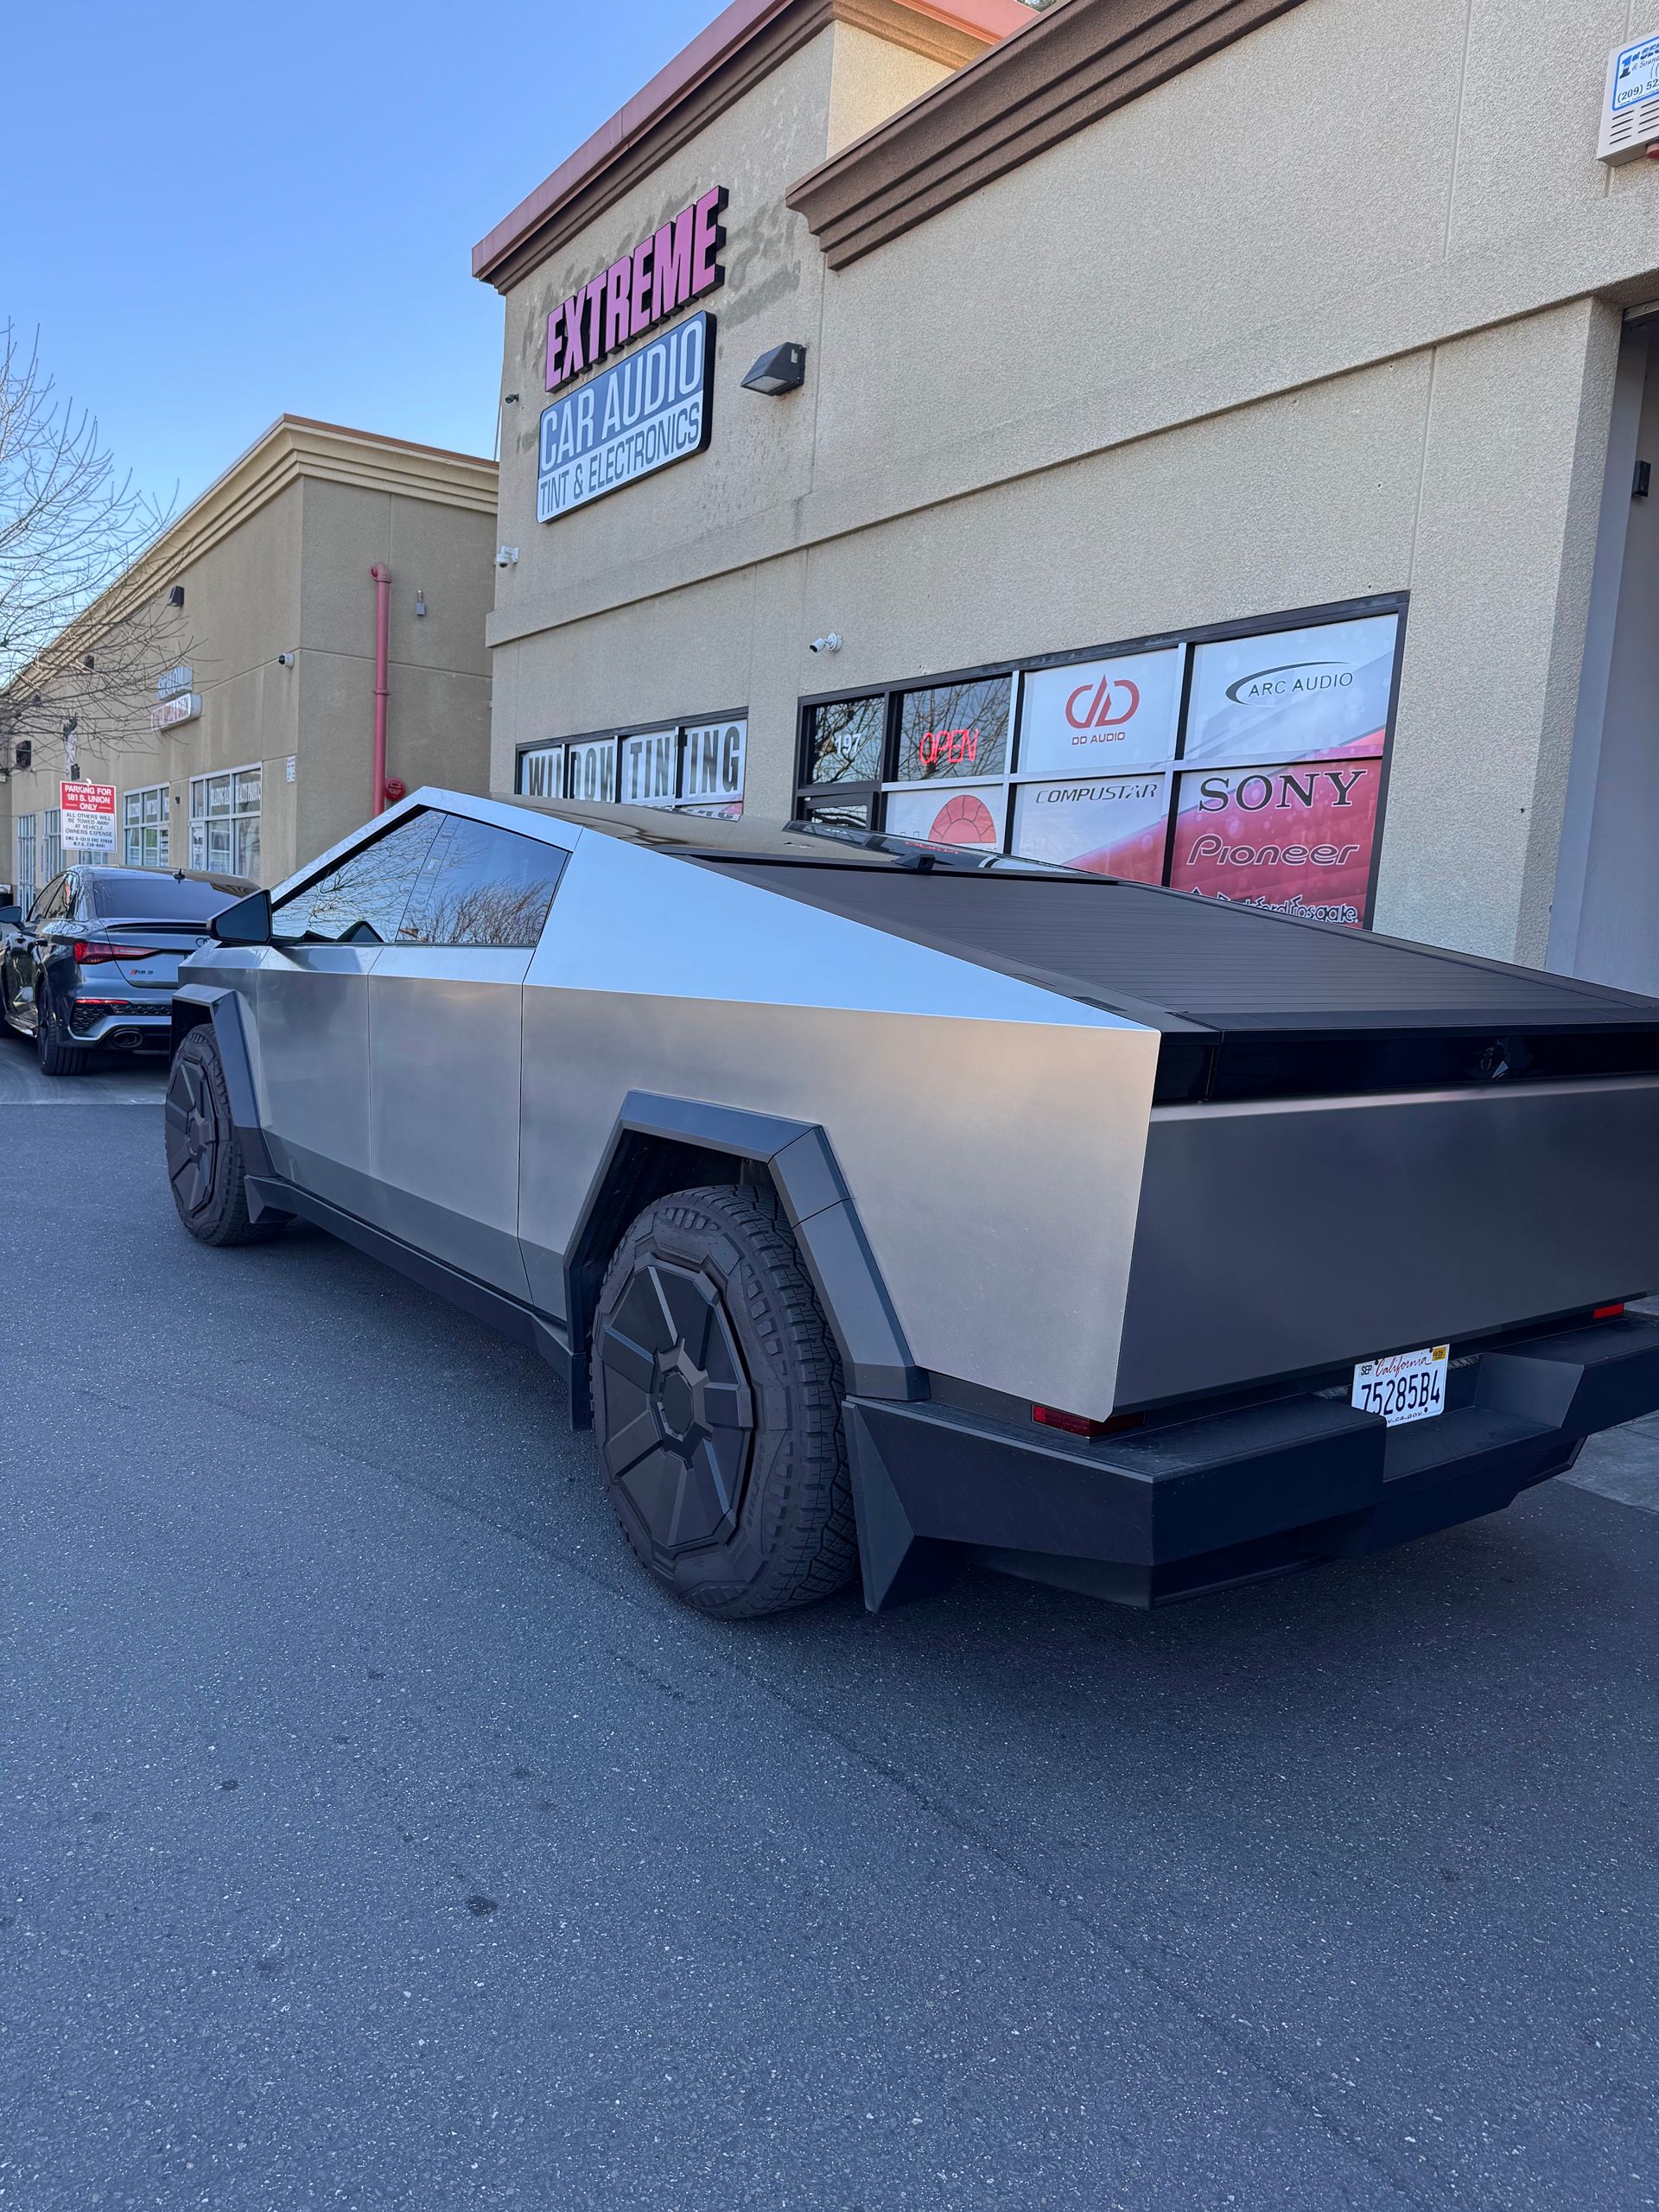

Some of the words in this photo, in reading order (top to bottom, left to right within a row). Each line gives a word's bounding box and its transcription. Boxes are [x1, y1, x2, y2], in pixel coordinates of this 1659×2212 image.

[1618, 85, 1643, 103] (209)
[546, 185, 721, 392] EXTREME
[541, 388, 594, 471] CAR
[601, 320, 703, 440] AUDIO
[540, 469, 569, 515] TINT
[574, 462, 583, 499] &
[588, 401, 700, 493] ELECTRONICS
[1248, 681, 1285, 697] ARC
[1293, 671, 1353, 691] AUDIO
[835, 733, 861, 754] 197
[919, 728, 979, 766] OPEN
[1071, 735, 1087, 746] DD
[1090, 732, 1126, 744] AUDIO
[65, 785, 95, 795] PARKING
[1036, 784, 1158, 804] COMPUSTAR
[1198, 770, 1367, 813] SONY
[1186, 834, 1360, 866] Pioneer
[1361, 1365, 1373, 1376] SEP
[1376, 1356, 1432, 1378] California
[1361, 1370, 1440, 1415] 75285B4
[1388, 1411, 1422, 1424] v.ca.gov
